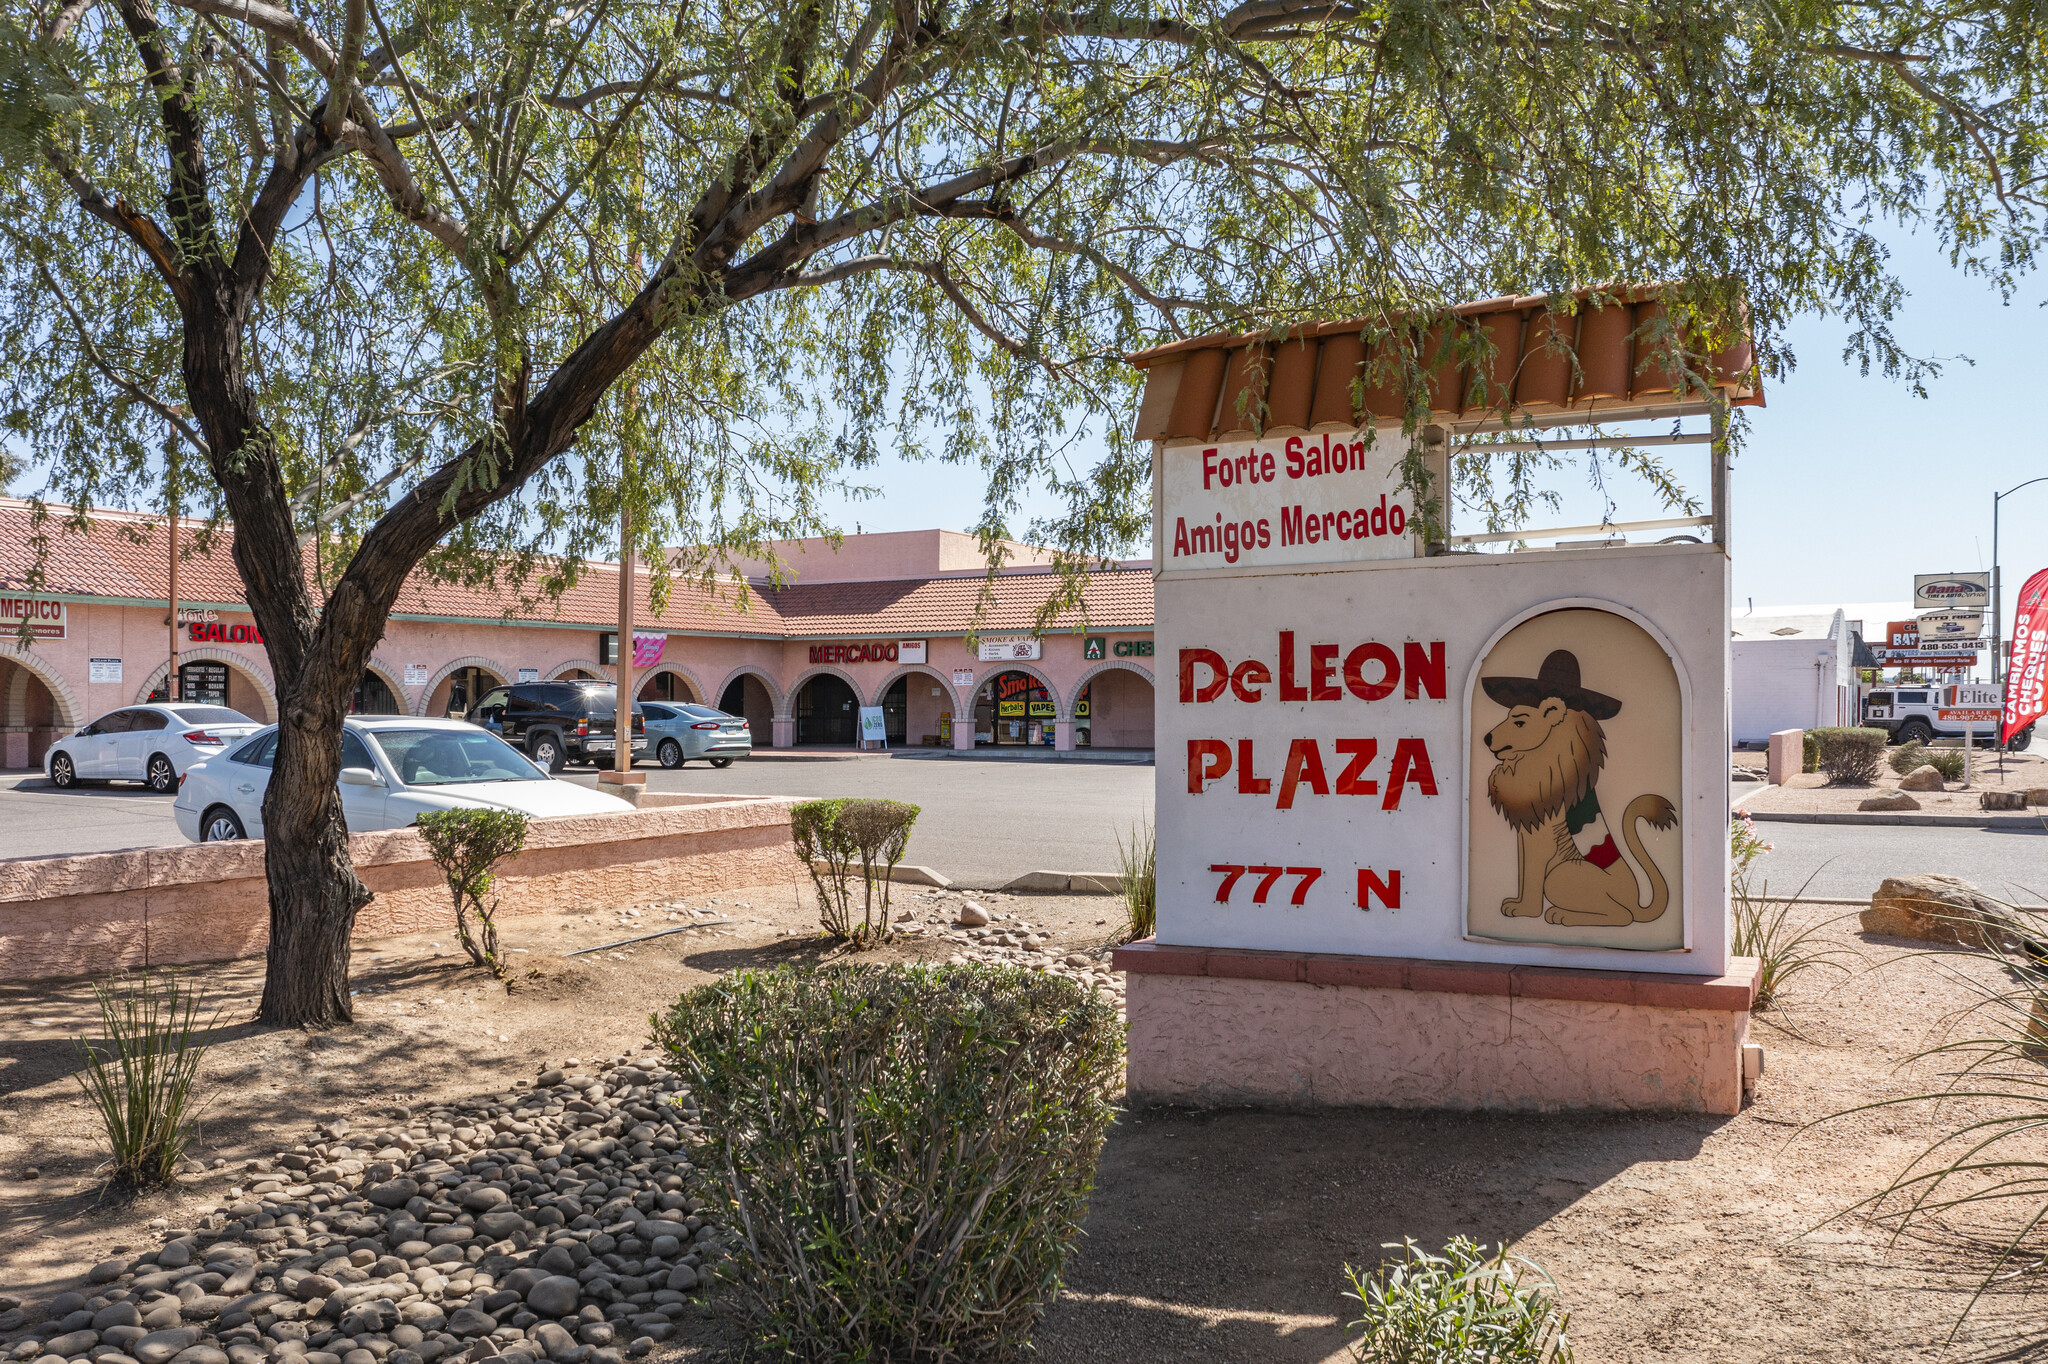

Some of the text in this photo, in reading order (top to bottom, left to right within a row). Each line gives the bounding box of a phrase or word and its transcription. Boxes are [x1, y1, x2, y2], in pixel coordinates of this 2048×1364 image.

[1202, 434, 1366, 490] Forte Salon
[1173, 494, 1406, 564] Amigos Mercado
[1925, 585, 1965, 594] Dana
[0, 598, 61, 620] MEDICO
[190, 622, 264, 644] SALON
[643, 643, 660, 653] Coming
[809, 643, 898, 664] MERCADO
[1113, 641, 1155, 657] CHE
[1920, 642, 1984, 651] 480-553-0413
[2005, 613, 2030, 725] CAMBIAMOS
[2018, 629, 2047, 716] CHEQUES
[1000, 702, 1024, 713] Herbals
[1959, 690, 1997, 704] Elite
[1187, 738, 1439, 810] PLAZA
[1210, 864, 1401, 909] 777 N
